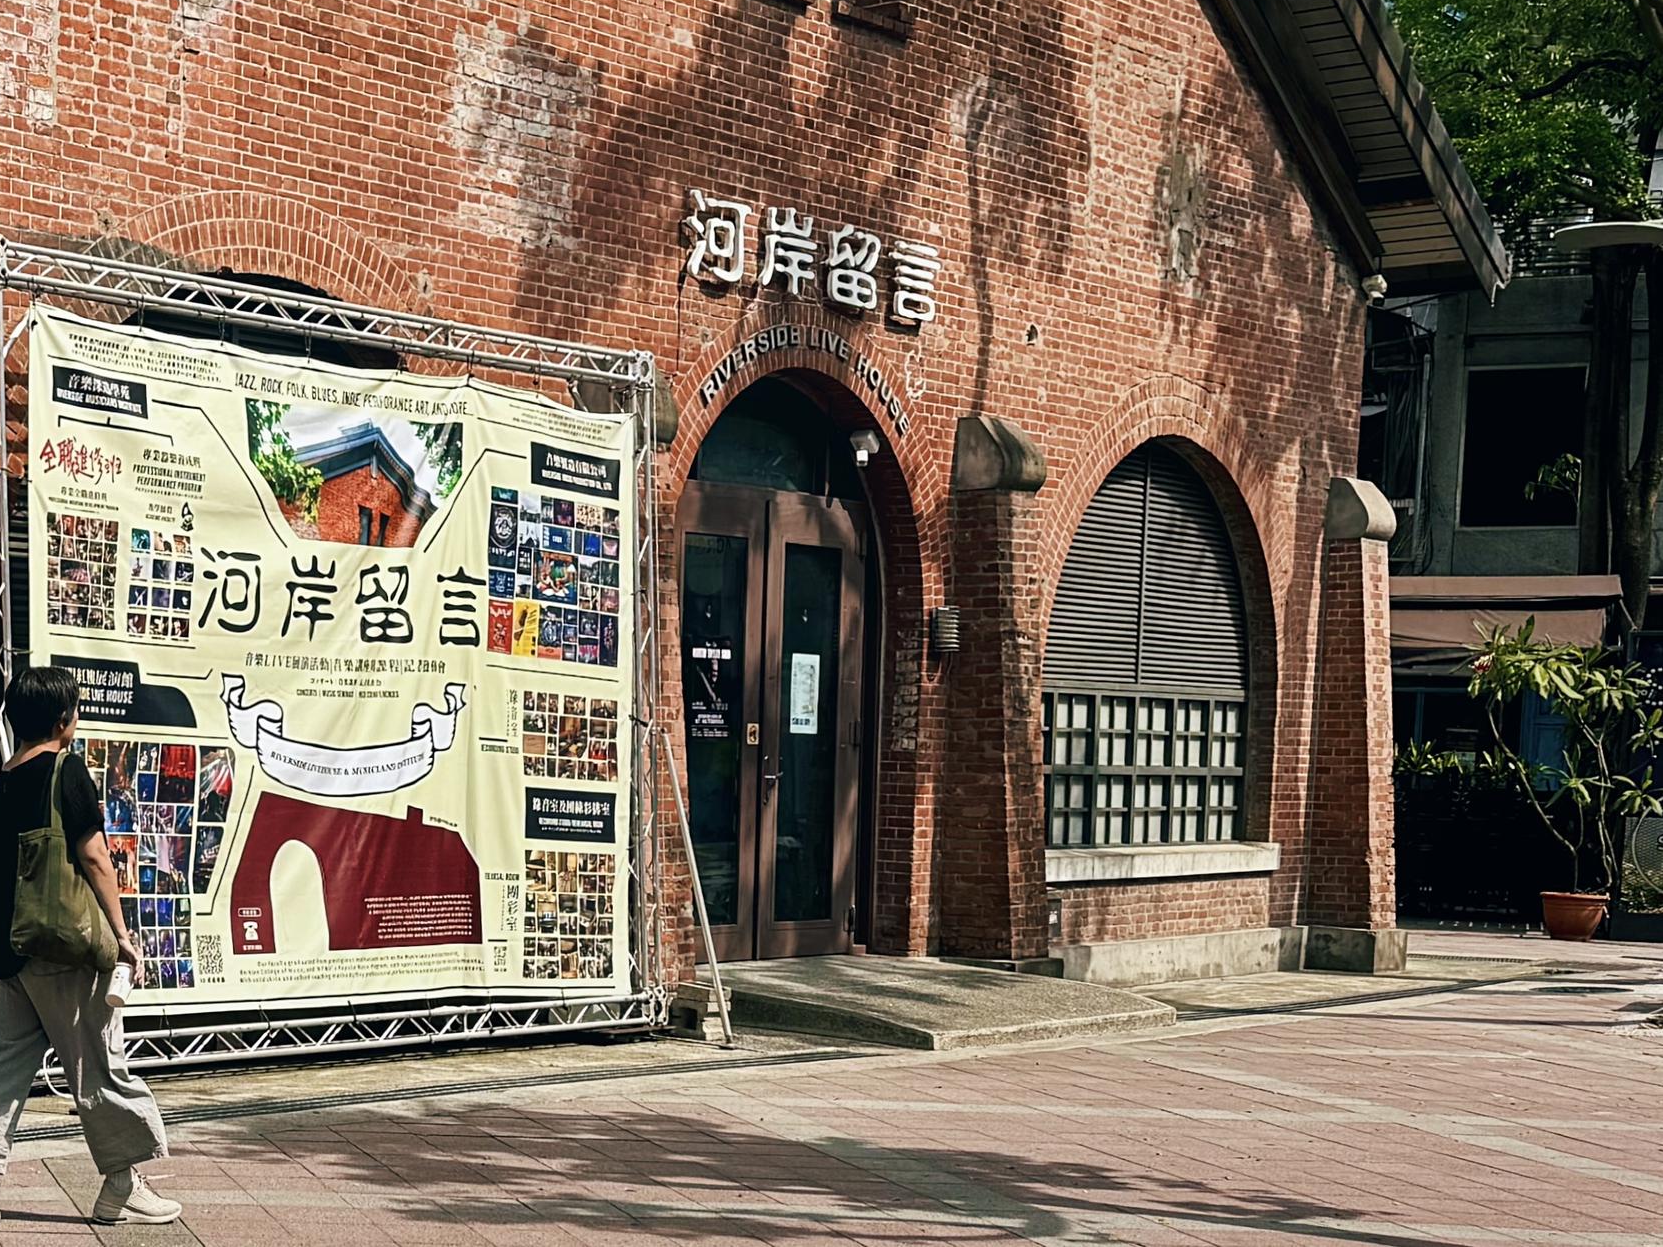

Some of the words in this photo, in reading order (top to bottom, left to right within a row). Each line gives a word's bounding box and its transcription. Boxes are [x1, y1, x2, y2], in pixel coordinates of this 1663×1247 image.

[686, 189, 942, 321] 河岸留言
[235, 372, 257, 391] JAZZ,
[260, 376, 283, 395] ROCK,
[311, 386, 339, 404] BLUES,
[701, 325, 800, 406] RIVERSIDE
[811, 326, 849, 360] LIVE
[856, 356, 910, 437] HOUSE
[198, 547, 487, 648] 河岸留言
[106, 690, 134, 704] HOUSE
[270, 751, 307, 770] RIVERSIDE
